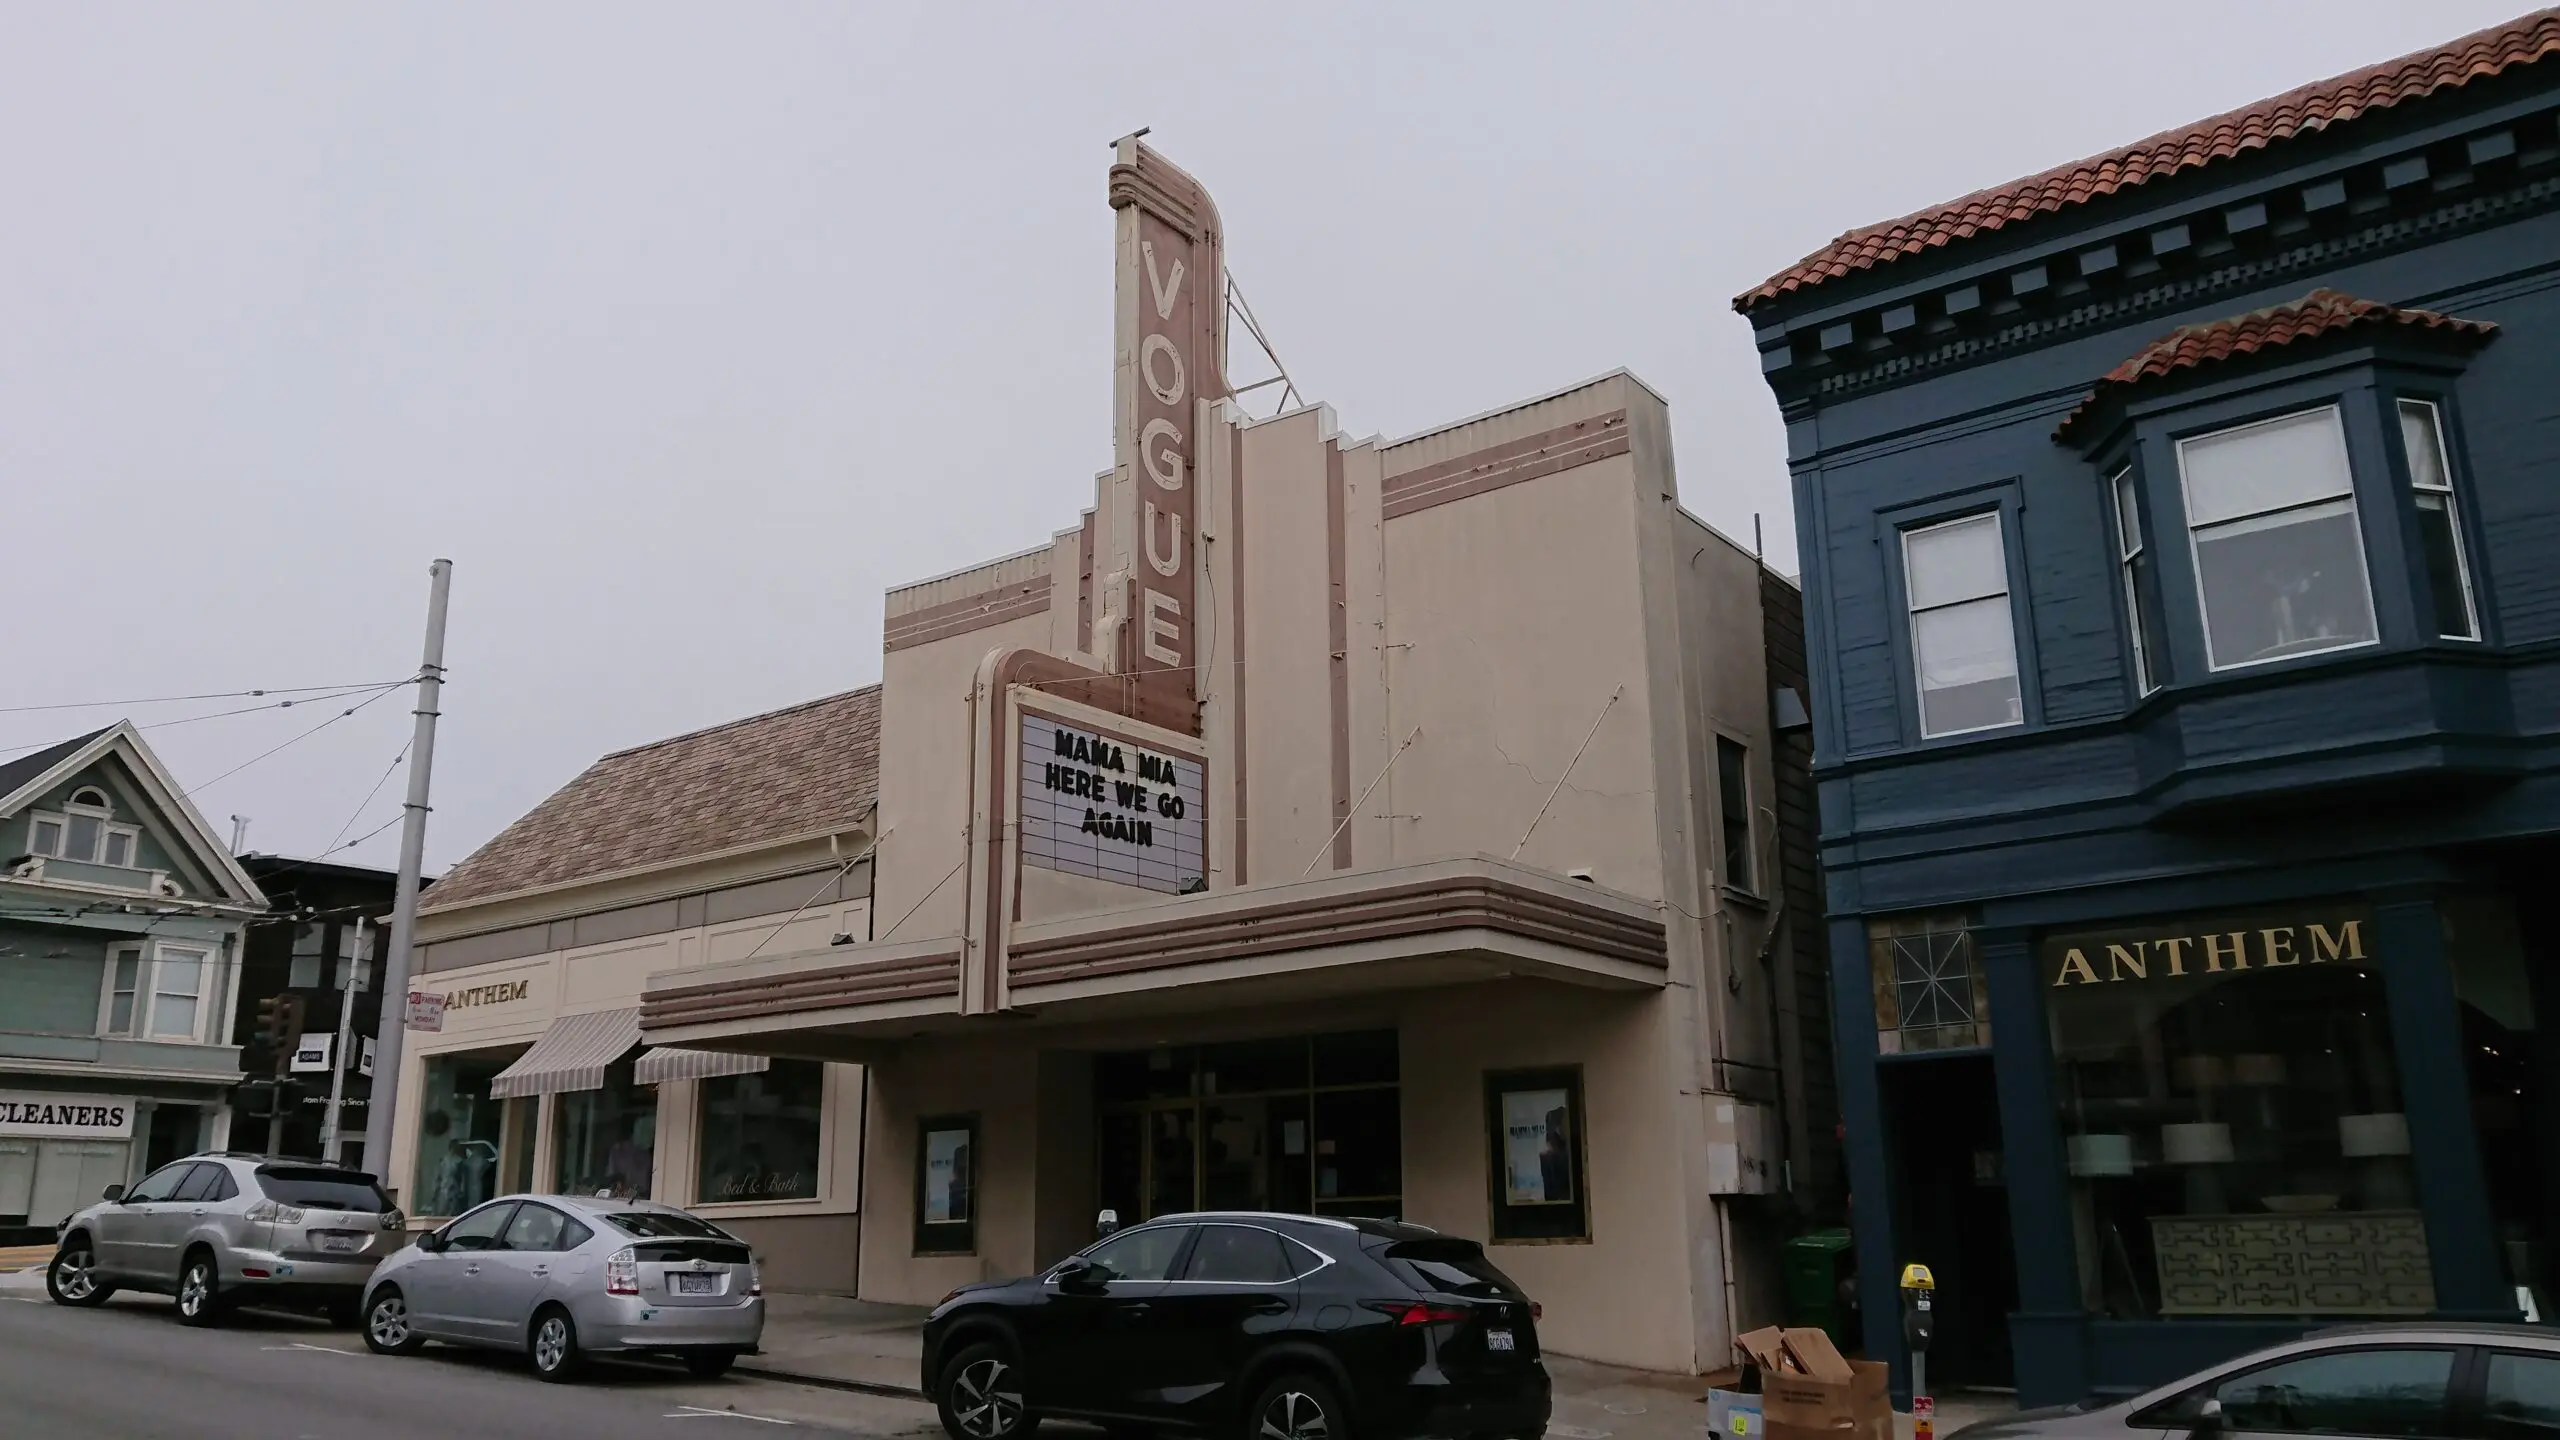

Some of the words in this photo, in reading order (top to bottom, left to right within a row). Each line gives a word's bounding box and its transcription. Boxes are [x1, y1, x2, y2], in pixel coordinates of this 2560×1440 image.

[1142, 241, 1185, 667] VOGUE
[1055, 729, 1125, 773] MAMA
[1139, 753, 1176, 787] MIA
[1045, 762, 1106, 802] HERE
[1115, 780, 1148, 812] WE
[1157, 793, 1184, 819] GO
[1081, 808, 1152, 847] AGAIN
[2052, 919, 2368, 987] ANTHEM
[442, 980, 529, 1011] ANTHEM
[415, 1015, 436, 1023] MONDAY
[347, 1097, 365, 1106] Since
[764, 1171, 800, 1194] Bath
